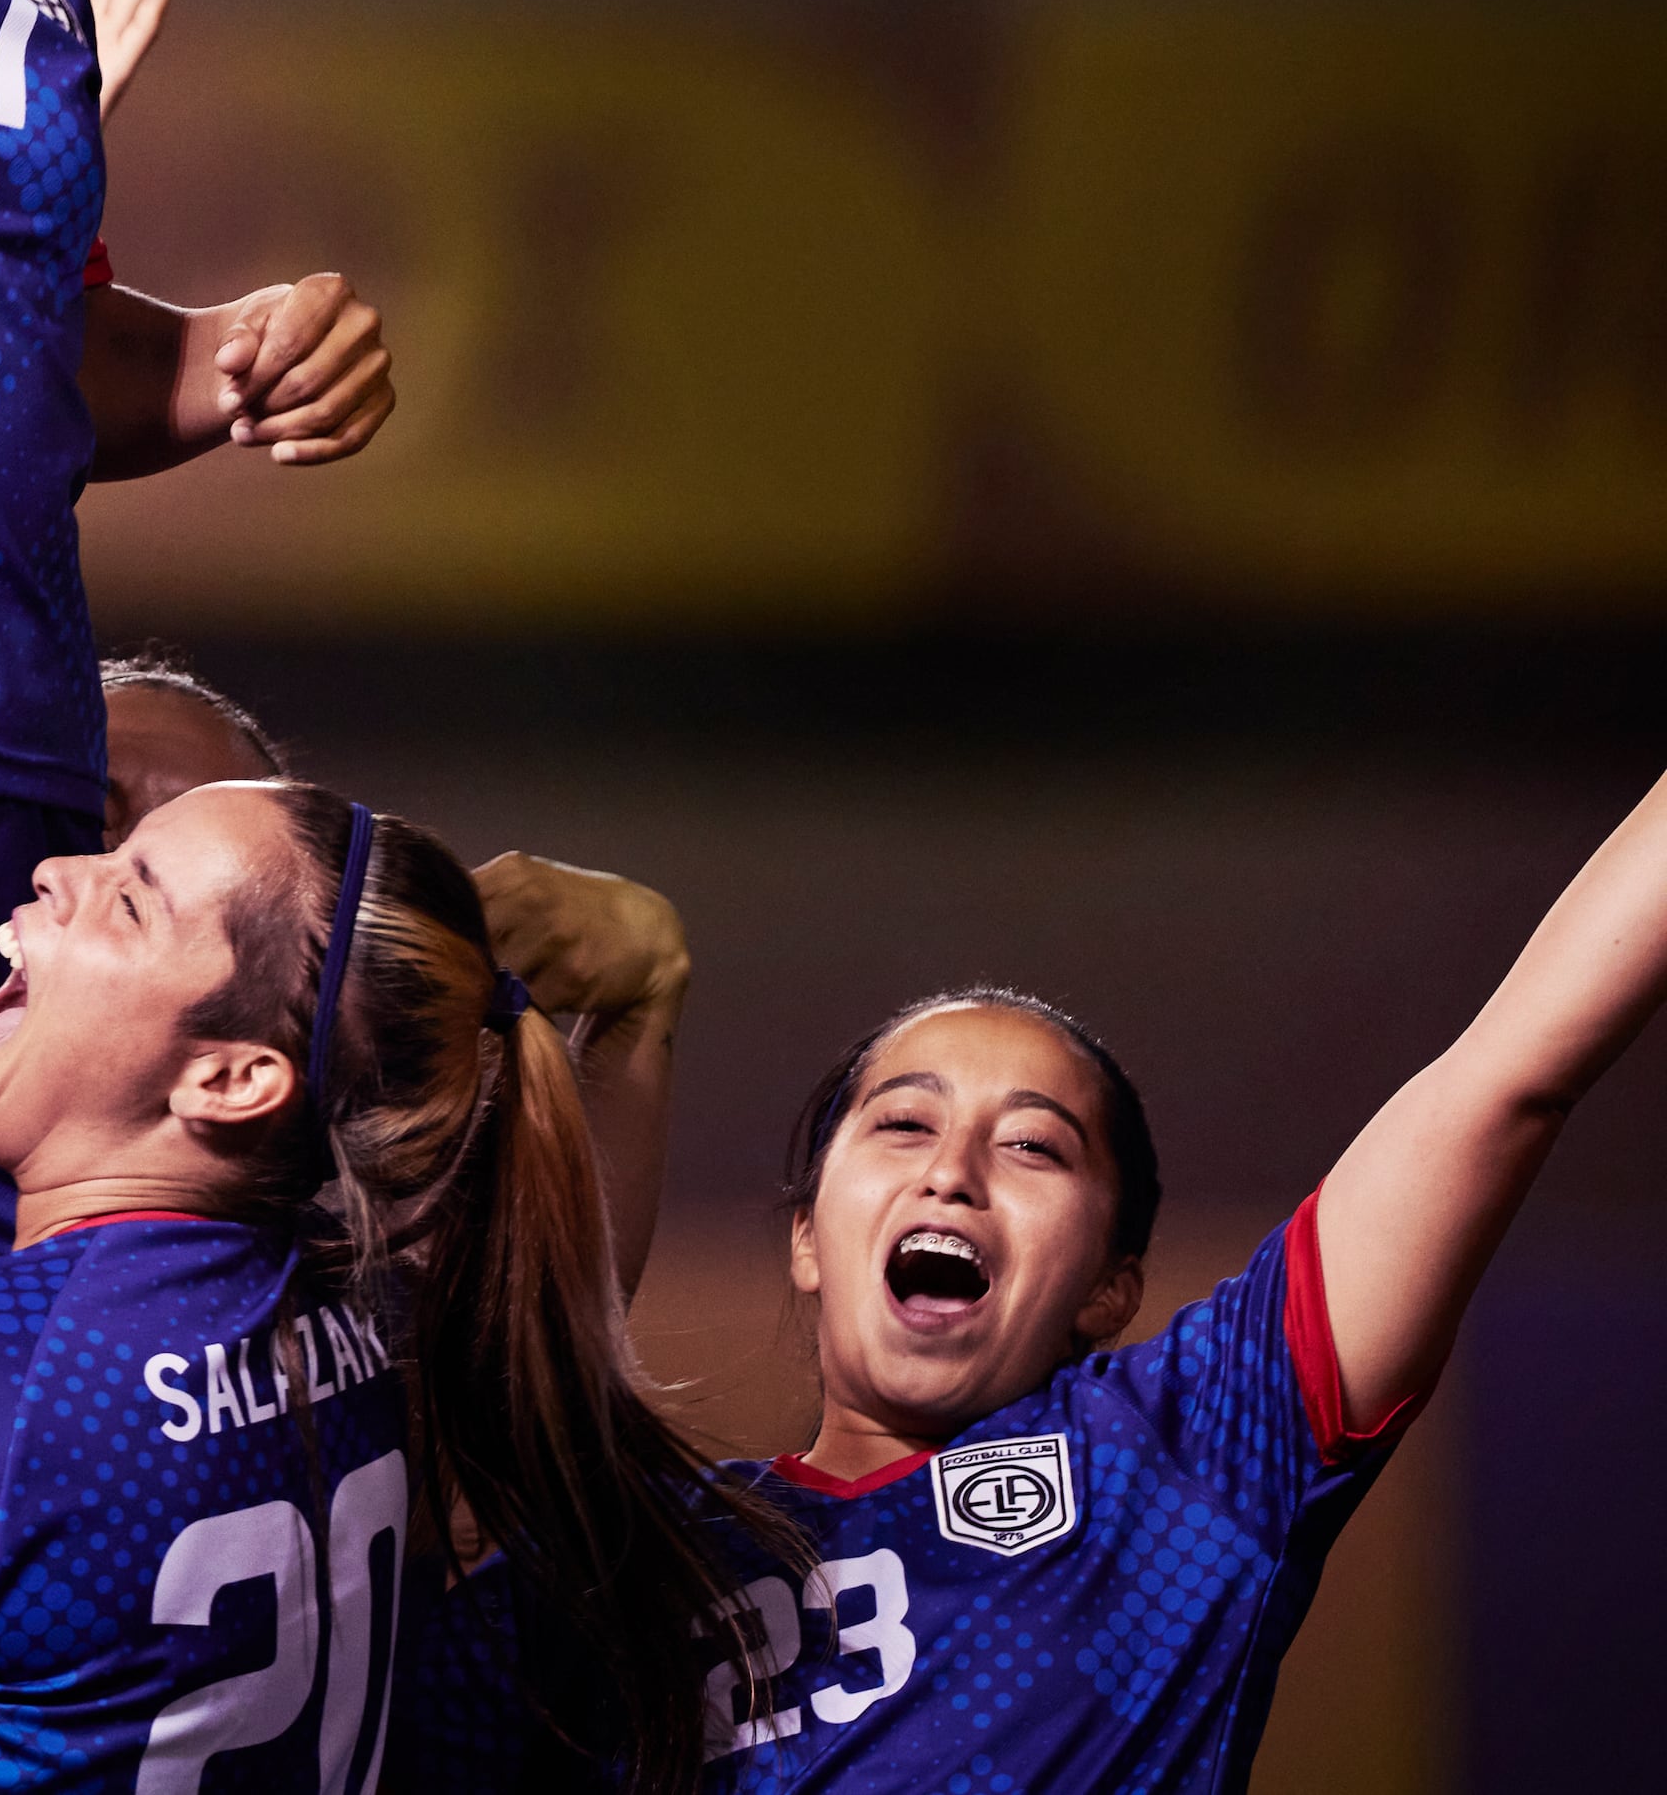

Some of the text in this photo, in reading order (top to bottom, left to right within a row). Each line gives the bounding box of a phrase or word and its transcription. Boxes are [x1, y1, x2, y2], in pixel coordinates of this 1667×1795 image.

[945, 1445, 1053, 1466] FOOTBALL CLUB
[135, 1448, 408, 1795] 20
[691, 1547, 917, 1766] 23
